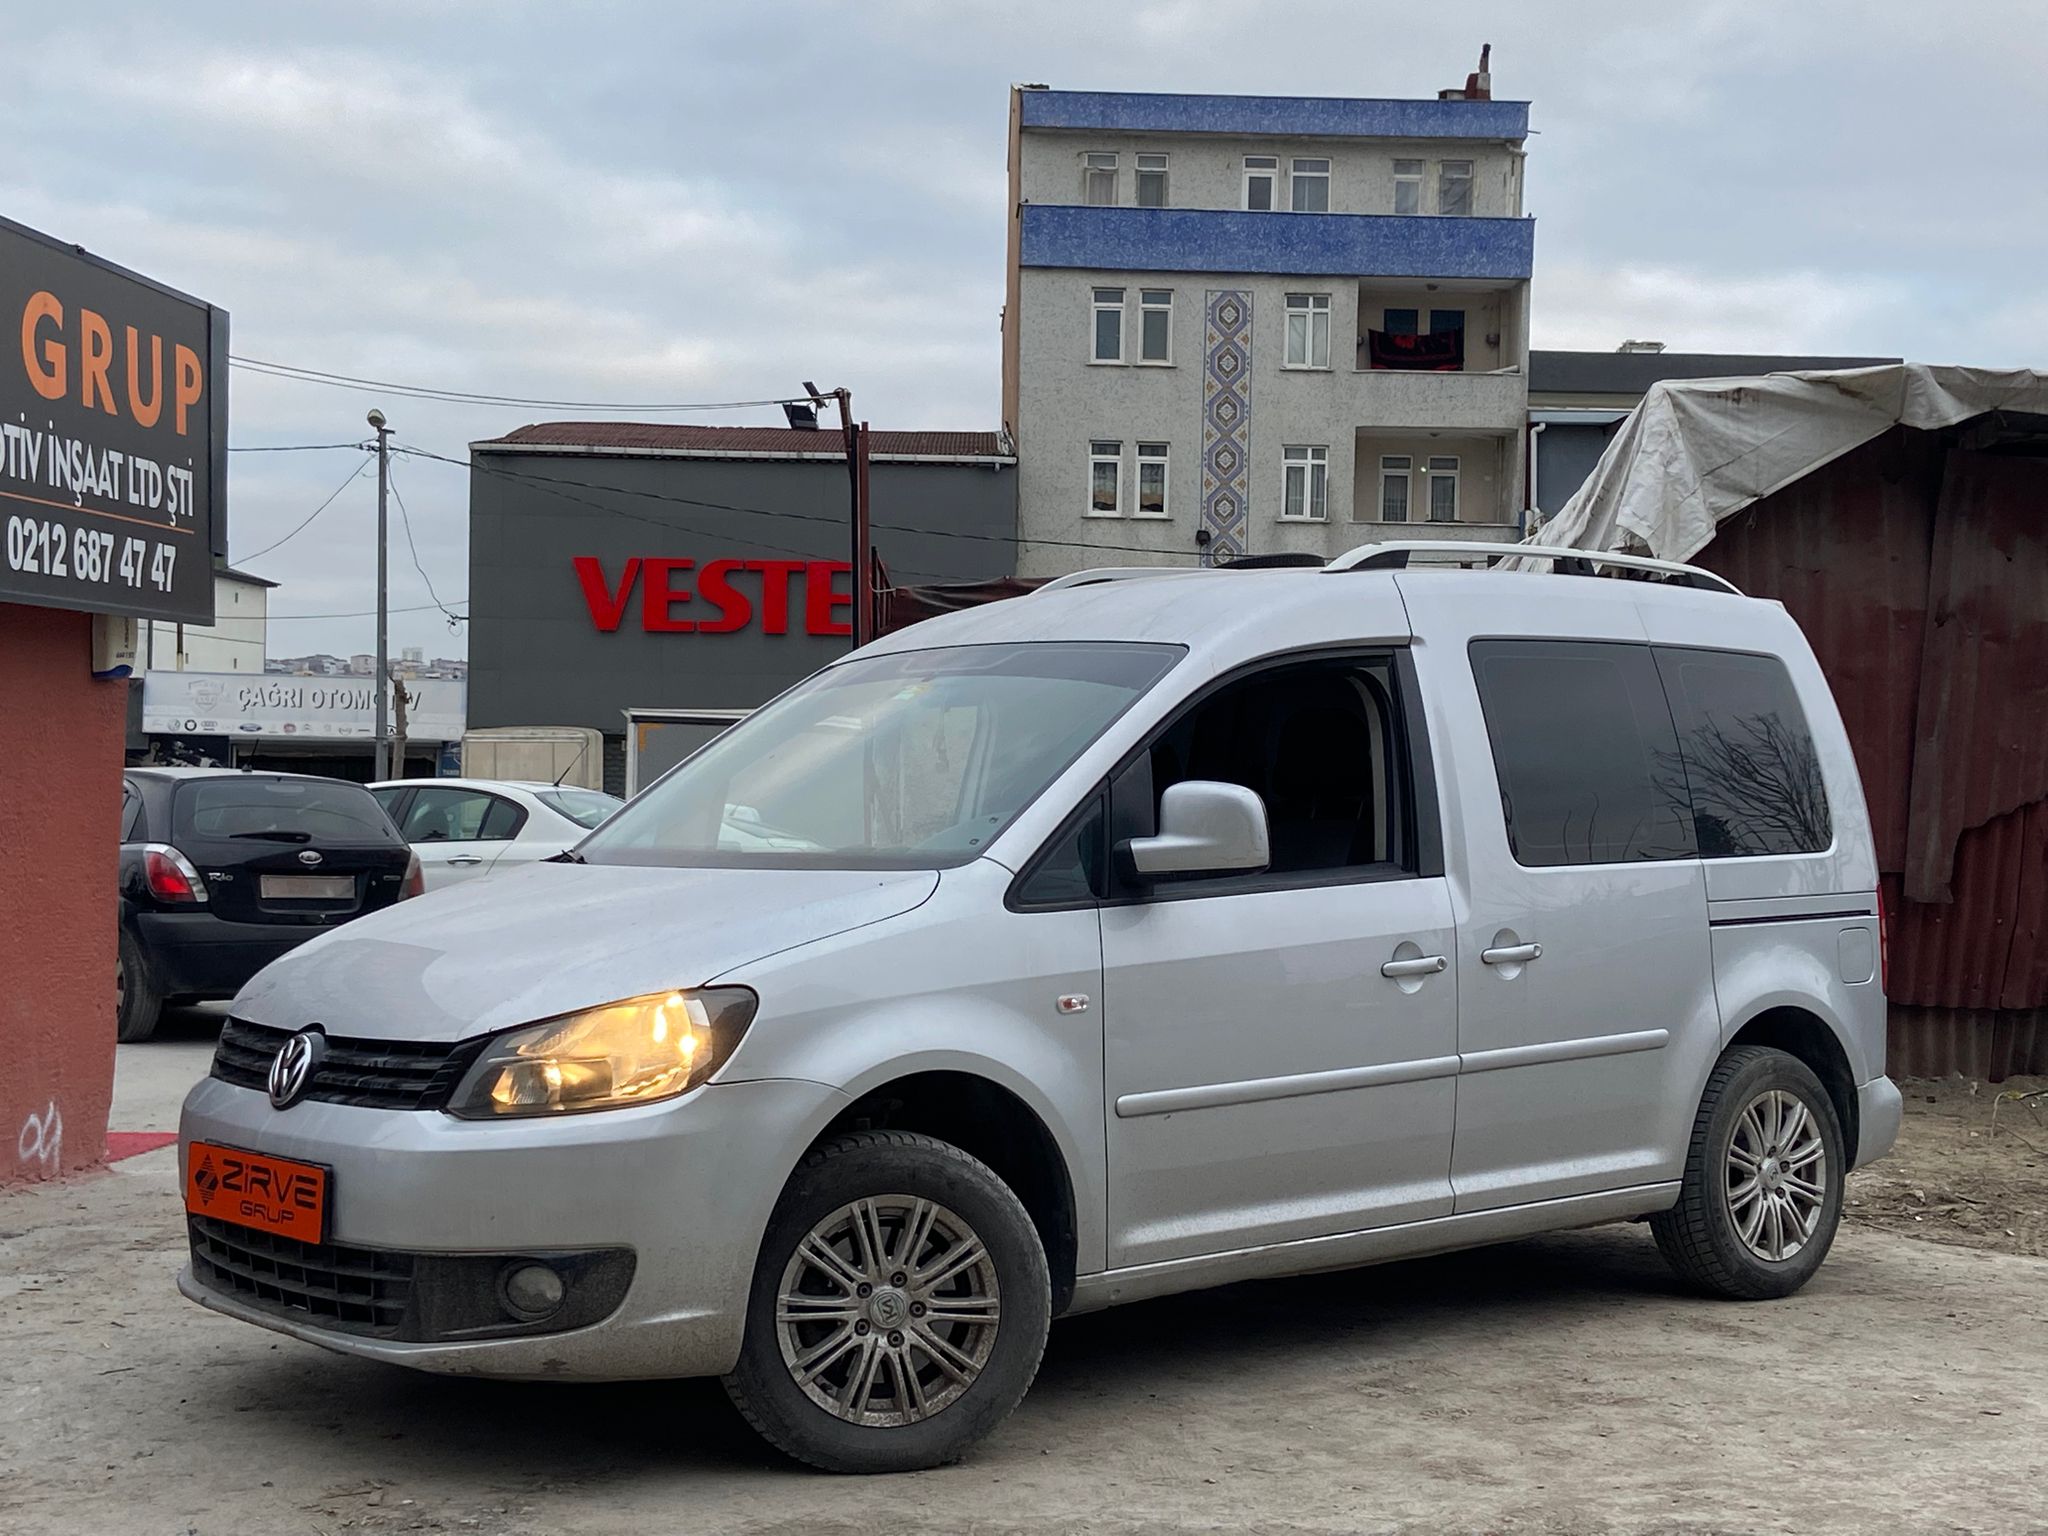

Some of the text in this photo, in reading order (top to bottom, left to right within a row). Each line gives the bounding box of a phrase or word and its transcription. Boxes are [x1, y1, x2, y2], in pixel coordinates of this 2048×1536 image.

[21, 291, 203, 436] GRUP
[0, 412, 194, 527] TİV İNŞAAT LTD ŞTİ
[7, 515, 177, 592] 0212 687 47 47
[238, 682, 303, 712] ÇAĞRI
[240, 1199, 295, 1225] GRUP
